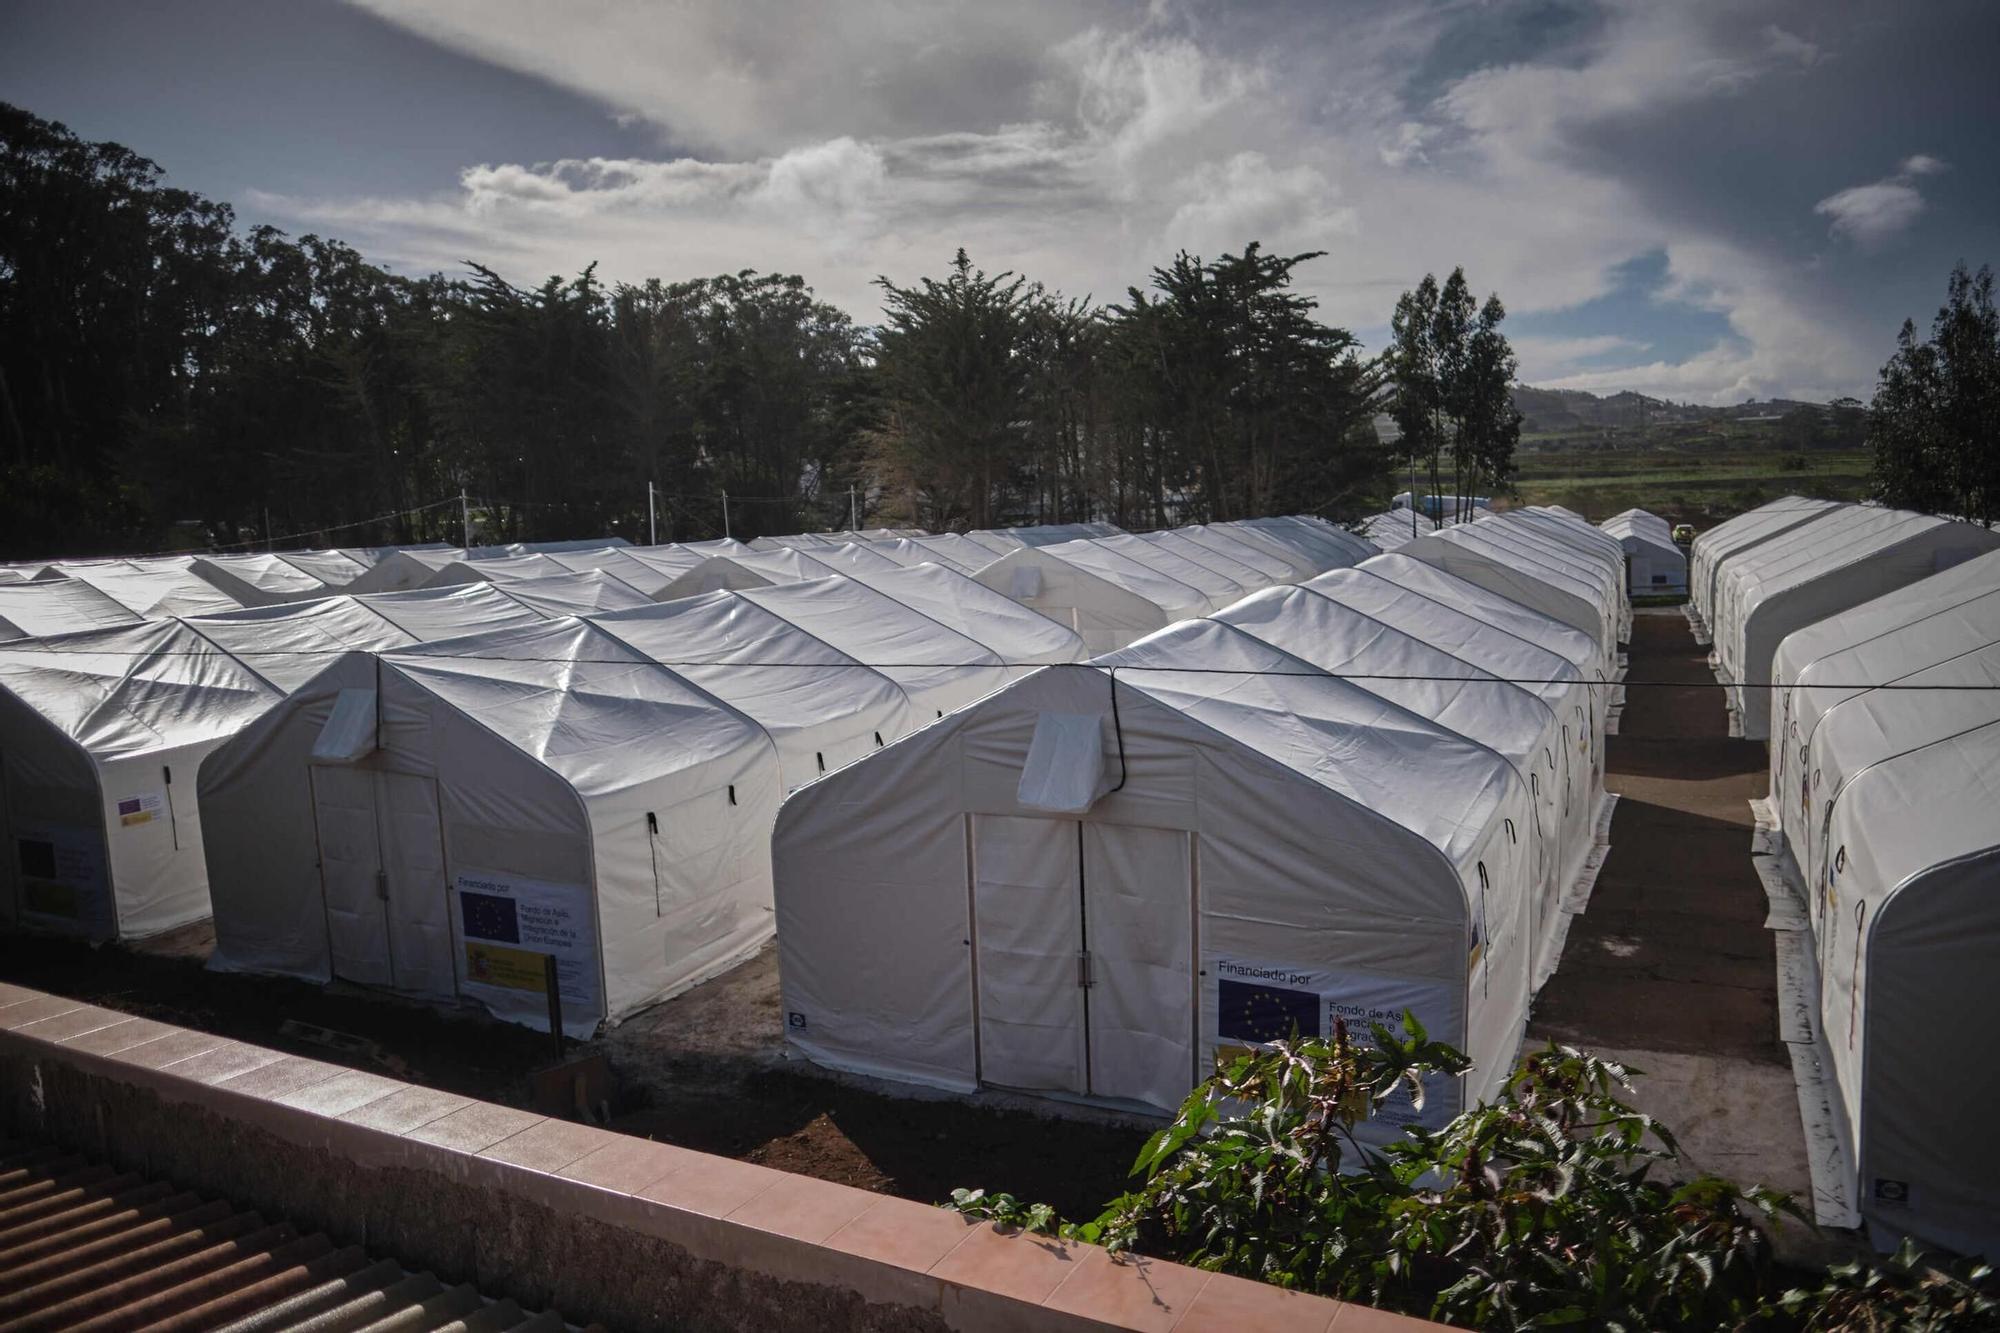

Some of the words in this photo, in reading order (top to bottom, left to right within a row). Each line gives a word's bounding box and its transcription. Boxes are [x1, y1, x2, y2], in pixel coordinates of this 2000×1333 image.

[1219, 960, 1286, 982] Financiado
[1290, 974, 1311, 985] por
[1329, 1002, 1365, 1016] Fondo
[1368, 1008, 1383, 1018] de
